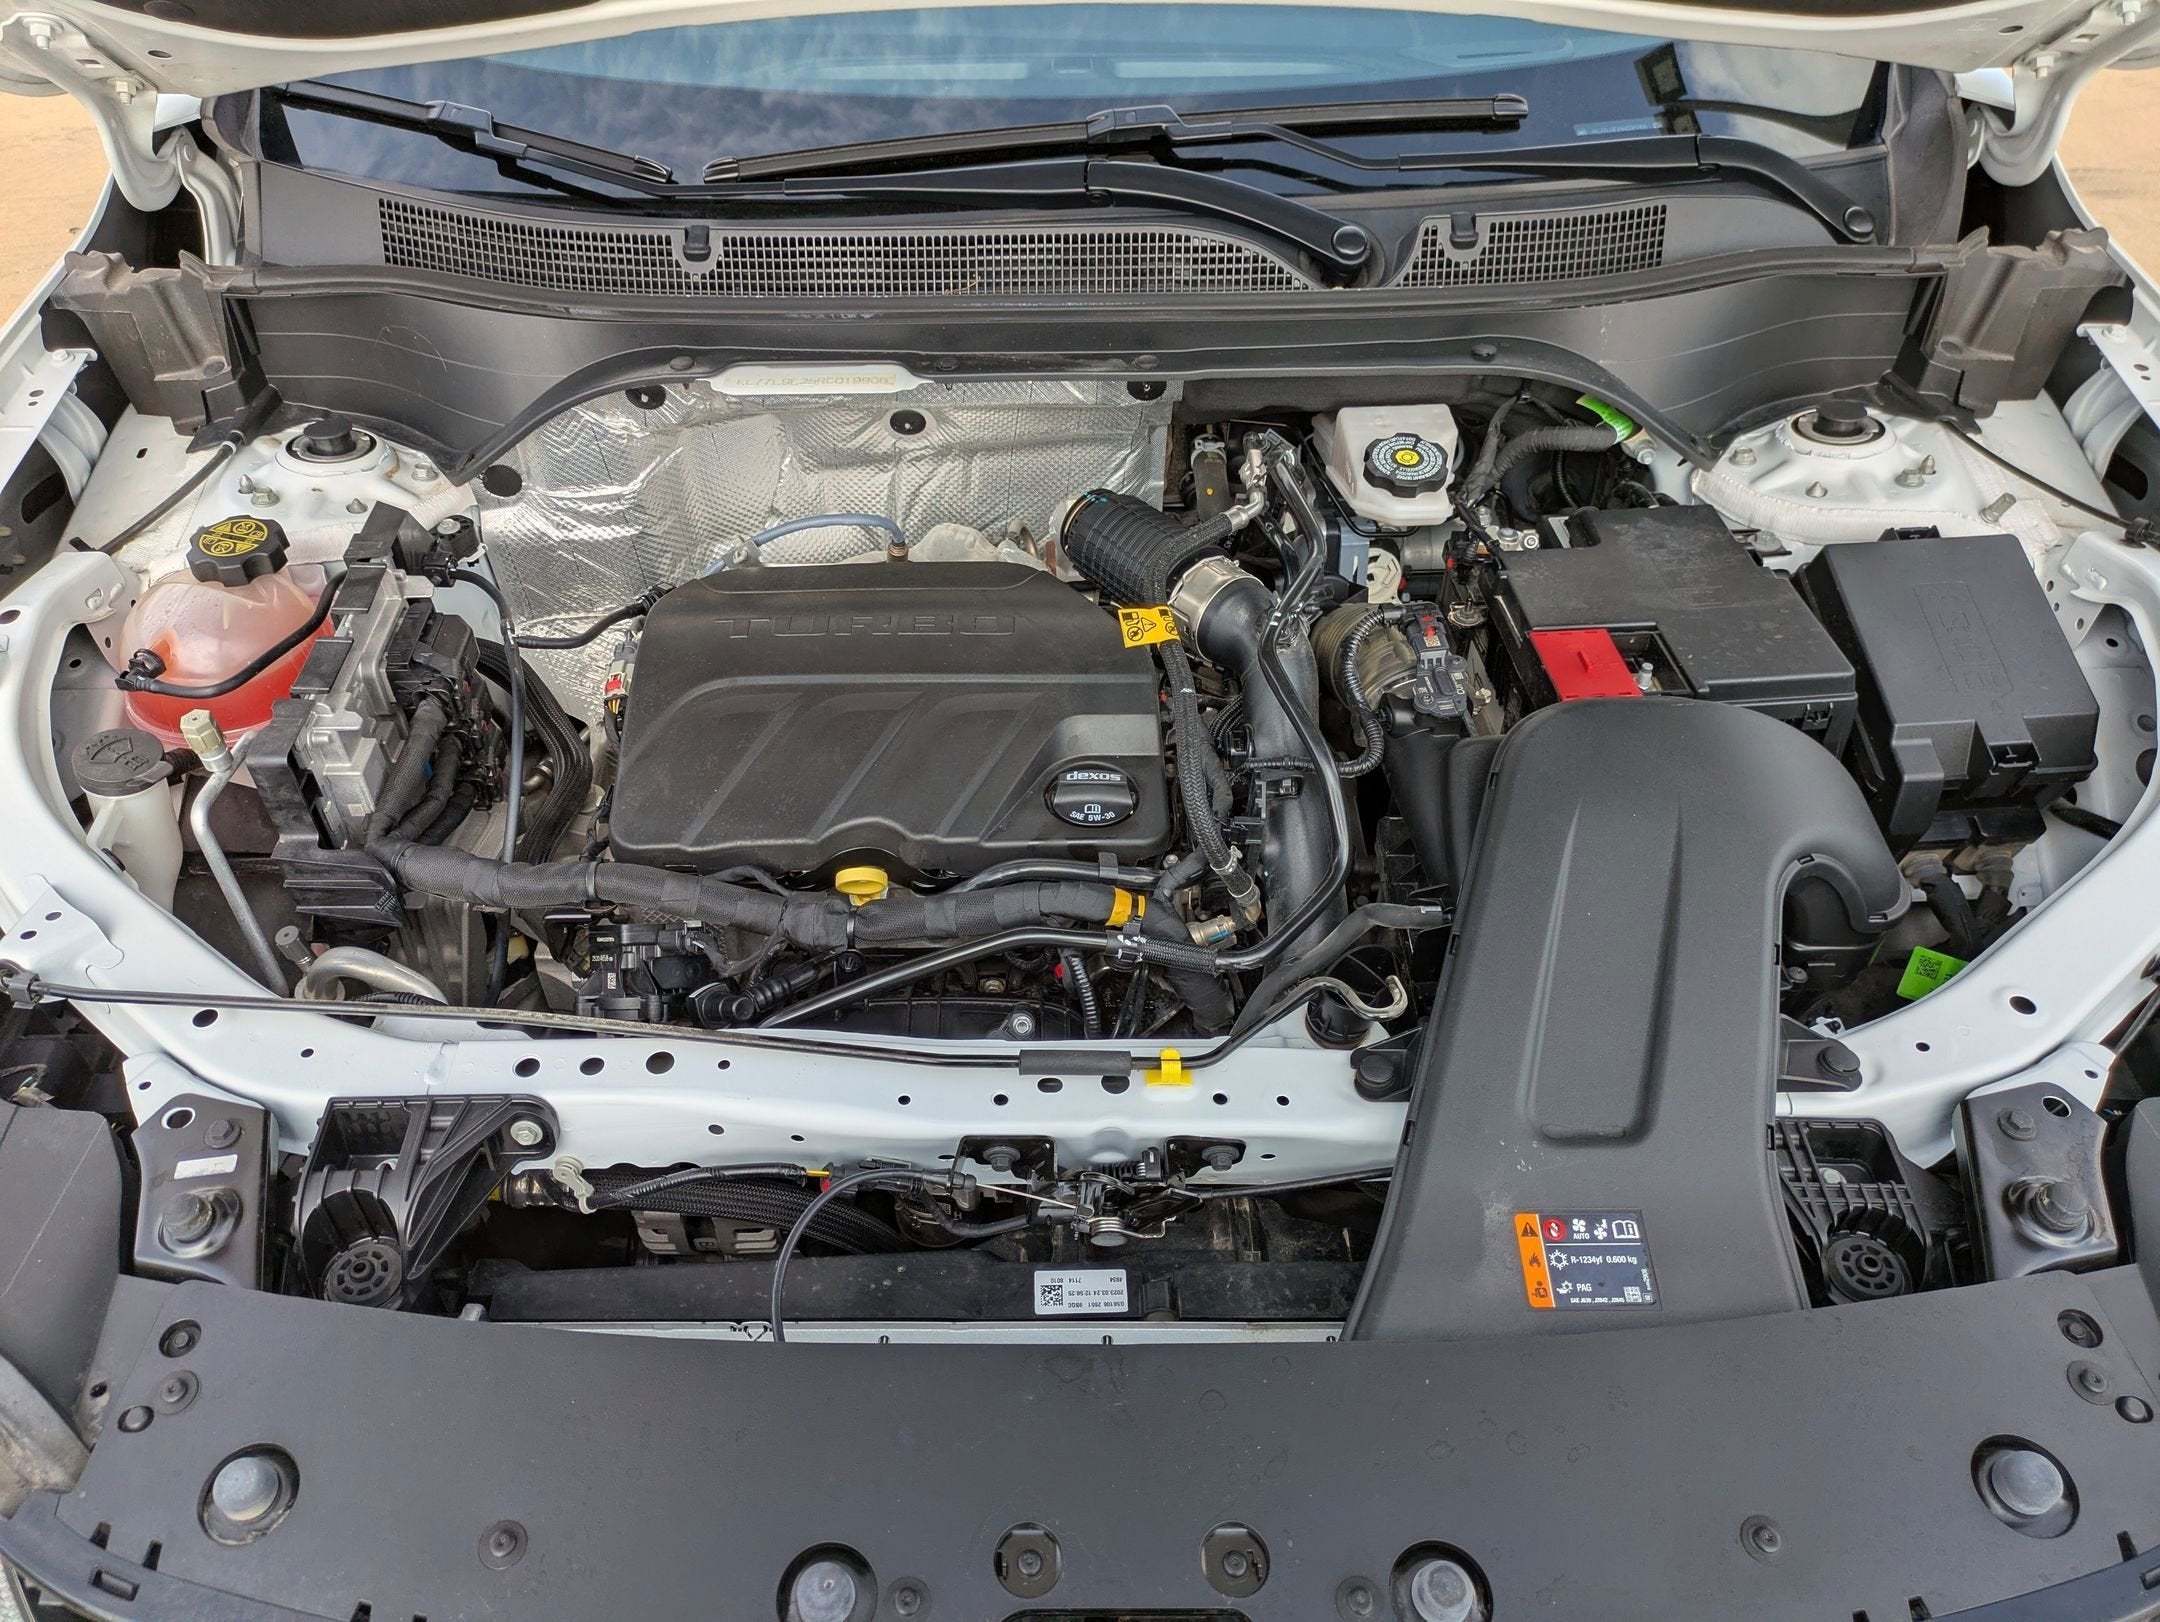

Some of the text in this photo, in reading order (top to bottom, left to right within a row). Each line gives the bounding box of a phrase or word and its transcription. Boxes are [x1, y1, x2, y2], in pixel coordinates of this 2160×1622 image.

[714, 615, 1017, 640] TURBO
[1066, 771, 1121, 781] dexos
[1069, 810, 1116, 822] SAE 5W-30
[1573, 1232, 1590, 1240] AUTO
[1571, 1255, 1603, 1265] R-1234yf
[1628, 1255, 1637, 1265] kg
[1576, 1284, 1592, 1292] PAG
